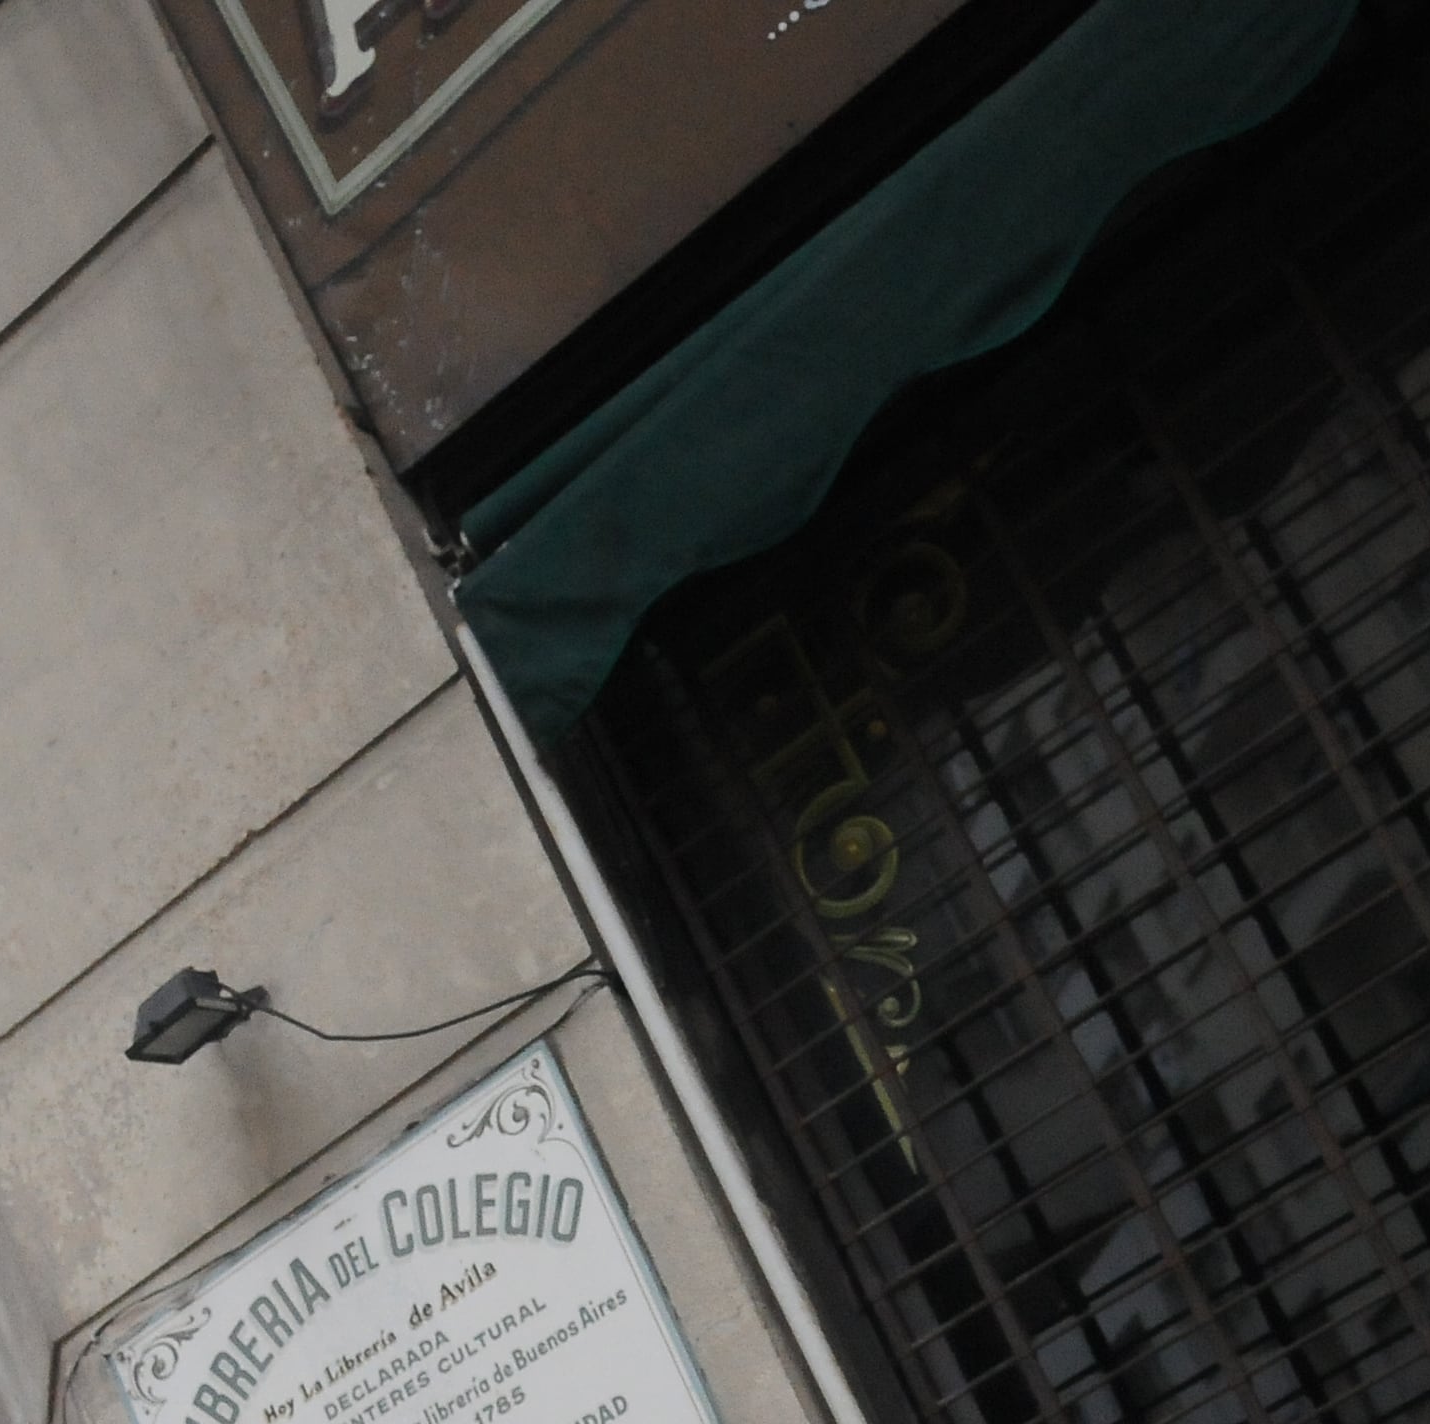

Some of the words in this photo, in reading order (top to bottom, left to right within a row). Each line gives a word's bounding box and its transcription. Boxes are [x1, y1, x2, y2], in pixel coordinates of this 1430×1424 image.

[326, 1234, 381, 1290] DEL
[380, 1170, 585, 1259] COLEGIO
[262, 1397, 296, 1424] Hoy
[298, 1379, 324, 1403] La
[408, 1302, 434, 1331] de
[439, 1261, 498, 1312] Avila
[322, 1329, 451, 1422] DECLARADA
[436, 1296, 548, 1375] CULTURAL
[492, 1361, 515, 1386] de
[510, 1319, 581, 1372] Buenos
[577, 1288, 629, 1330] Aires
